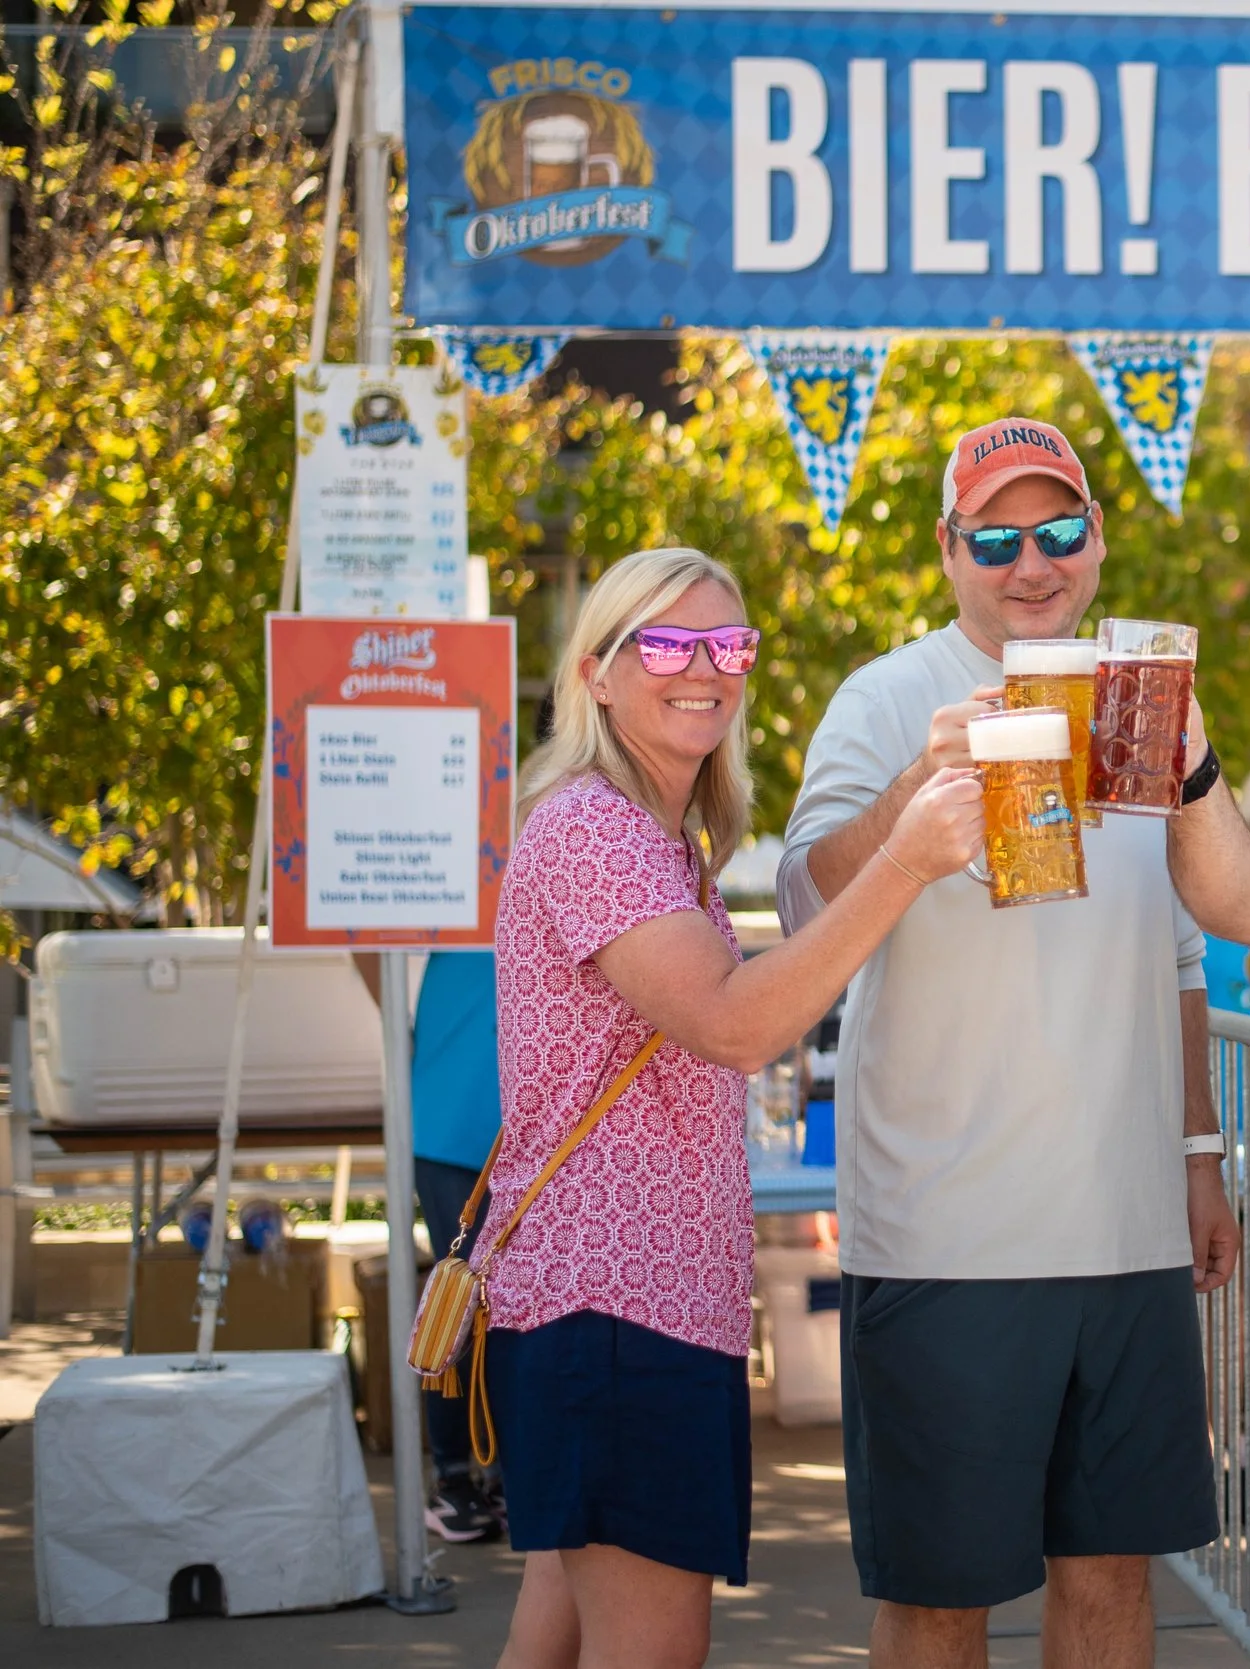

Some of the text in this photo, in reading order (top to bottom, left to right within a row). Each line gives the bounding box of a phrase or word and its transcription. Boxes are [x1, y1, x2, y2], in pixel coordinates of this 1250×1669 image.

[489, 57, 631, 96] FRISCO
[731, 57, 1158, 275] BIER!
[464, 196, 654, 260] Oktoberfest
[974, 427, 1063, 465] ILLINOIS
[350, 627, 436, 670] Shiner
[340, 671, 447, 702] Oktoberfest
